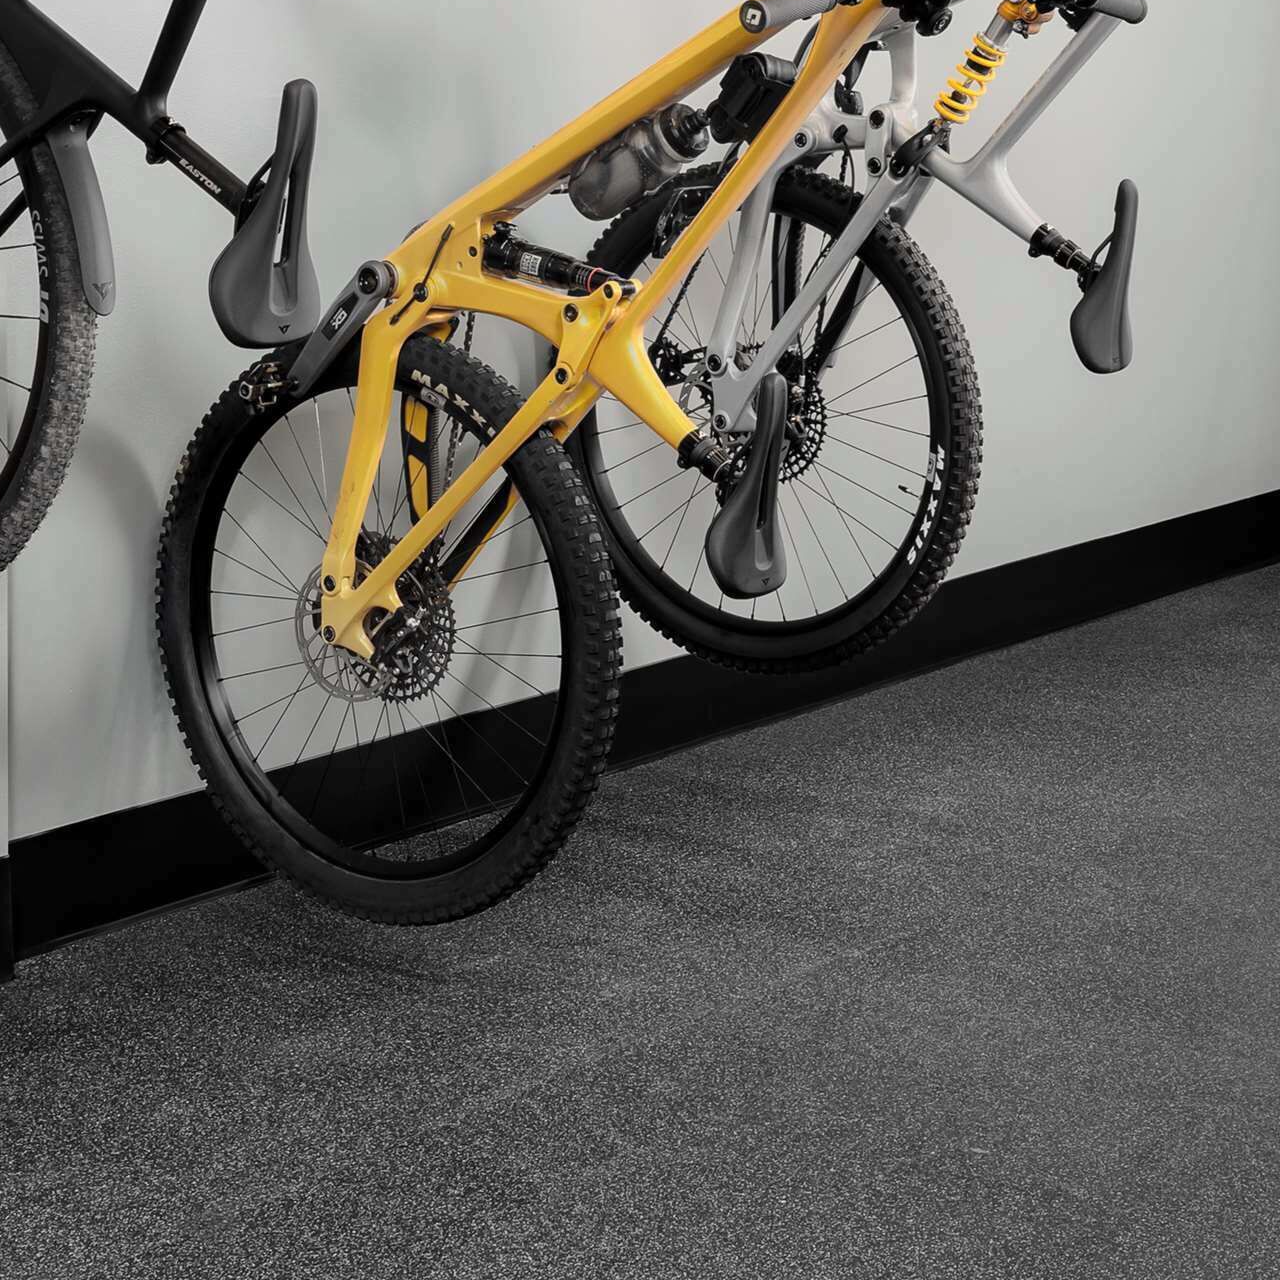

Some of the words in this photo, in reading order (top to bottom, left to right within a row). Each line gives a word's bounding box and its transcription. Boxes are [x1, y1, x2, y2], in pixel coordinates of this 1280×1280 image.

[179, 158, 222, 194] EASTON
[410, 368, 497, 438] MAXXI
[906, 444, 945, 566] MAXXIS
